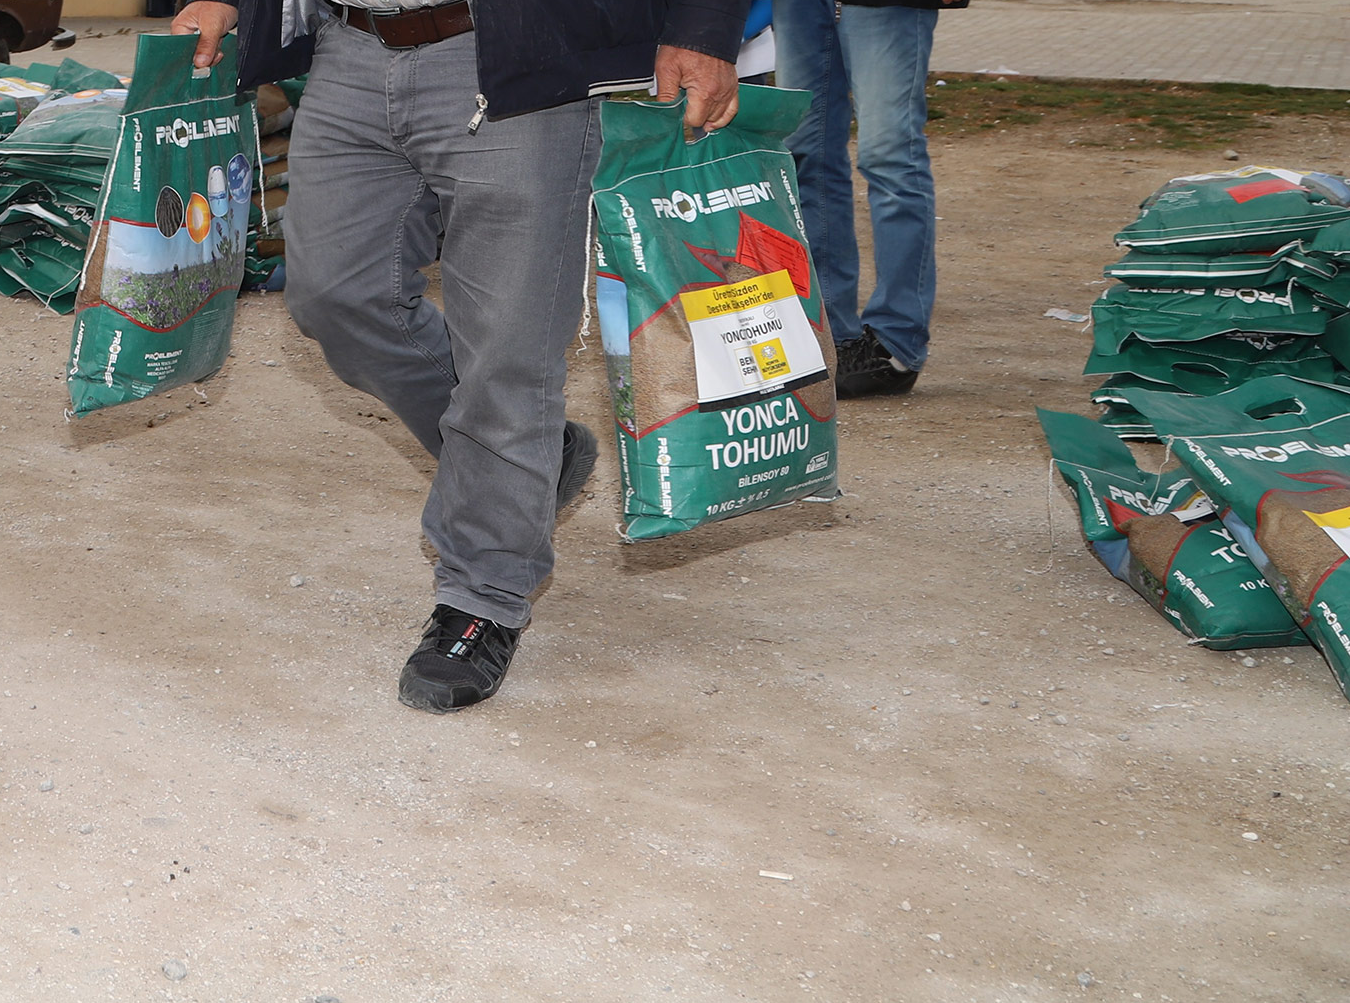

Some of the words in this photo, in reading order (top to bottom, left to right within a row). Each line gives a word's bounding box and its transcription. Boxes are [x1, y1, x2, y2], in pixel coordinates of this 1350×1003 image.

[156, 115, 240, 148] PROELEMENT
[132, 118, 143, 192] PROELEMENT
[721, 397, 799, 436] YONCA
[705, 423, 810, 470] TOHUMU
[1182, 438, 1232, 487] PROELEMENT
[738, 468, 780, 488] BİLENSOY
[706, 504, 719, 516] 10
[718, 499, 735, 513] KG
[1239, 581, 1256, 591] 10
[1256, 578, 1270, 588] K
